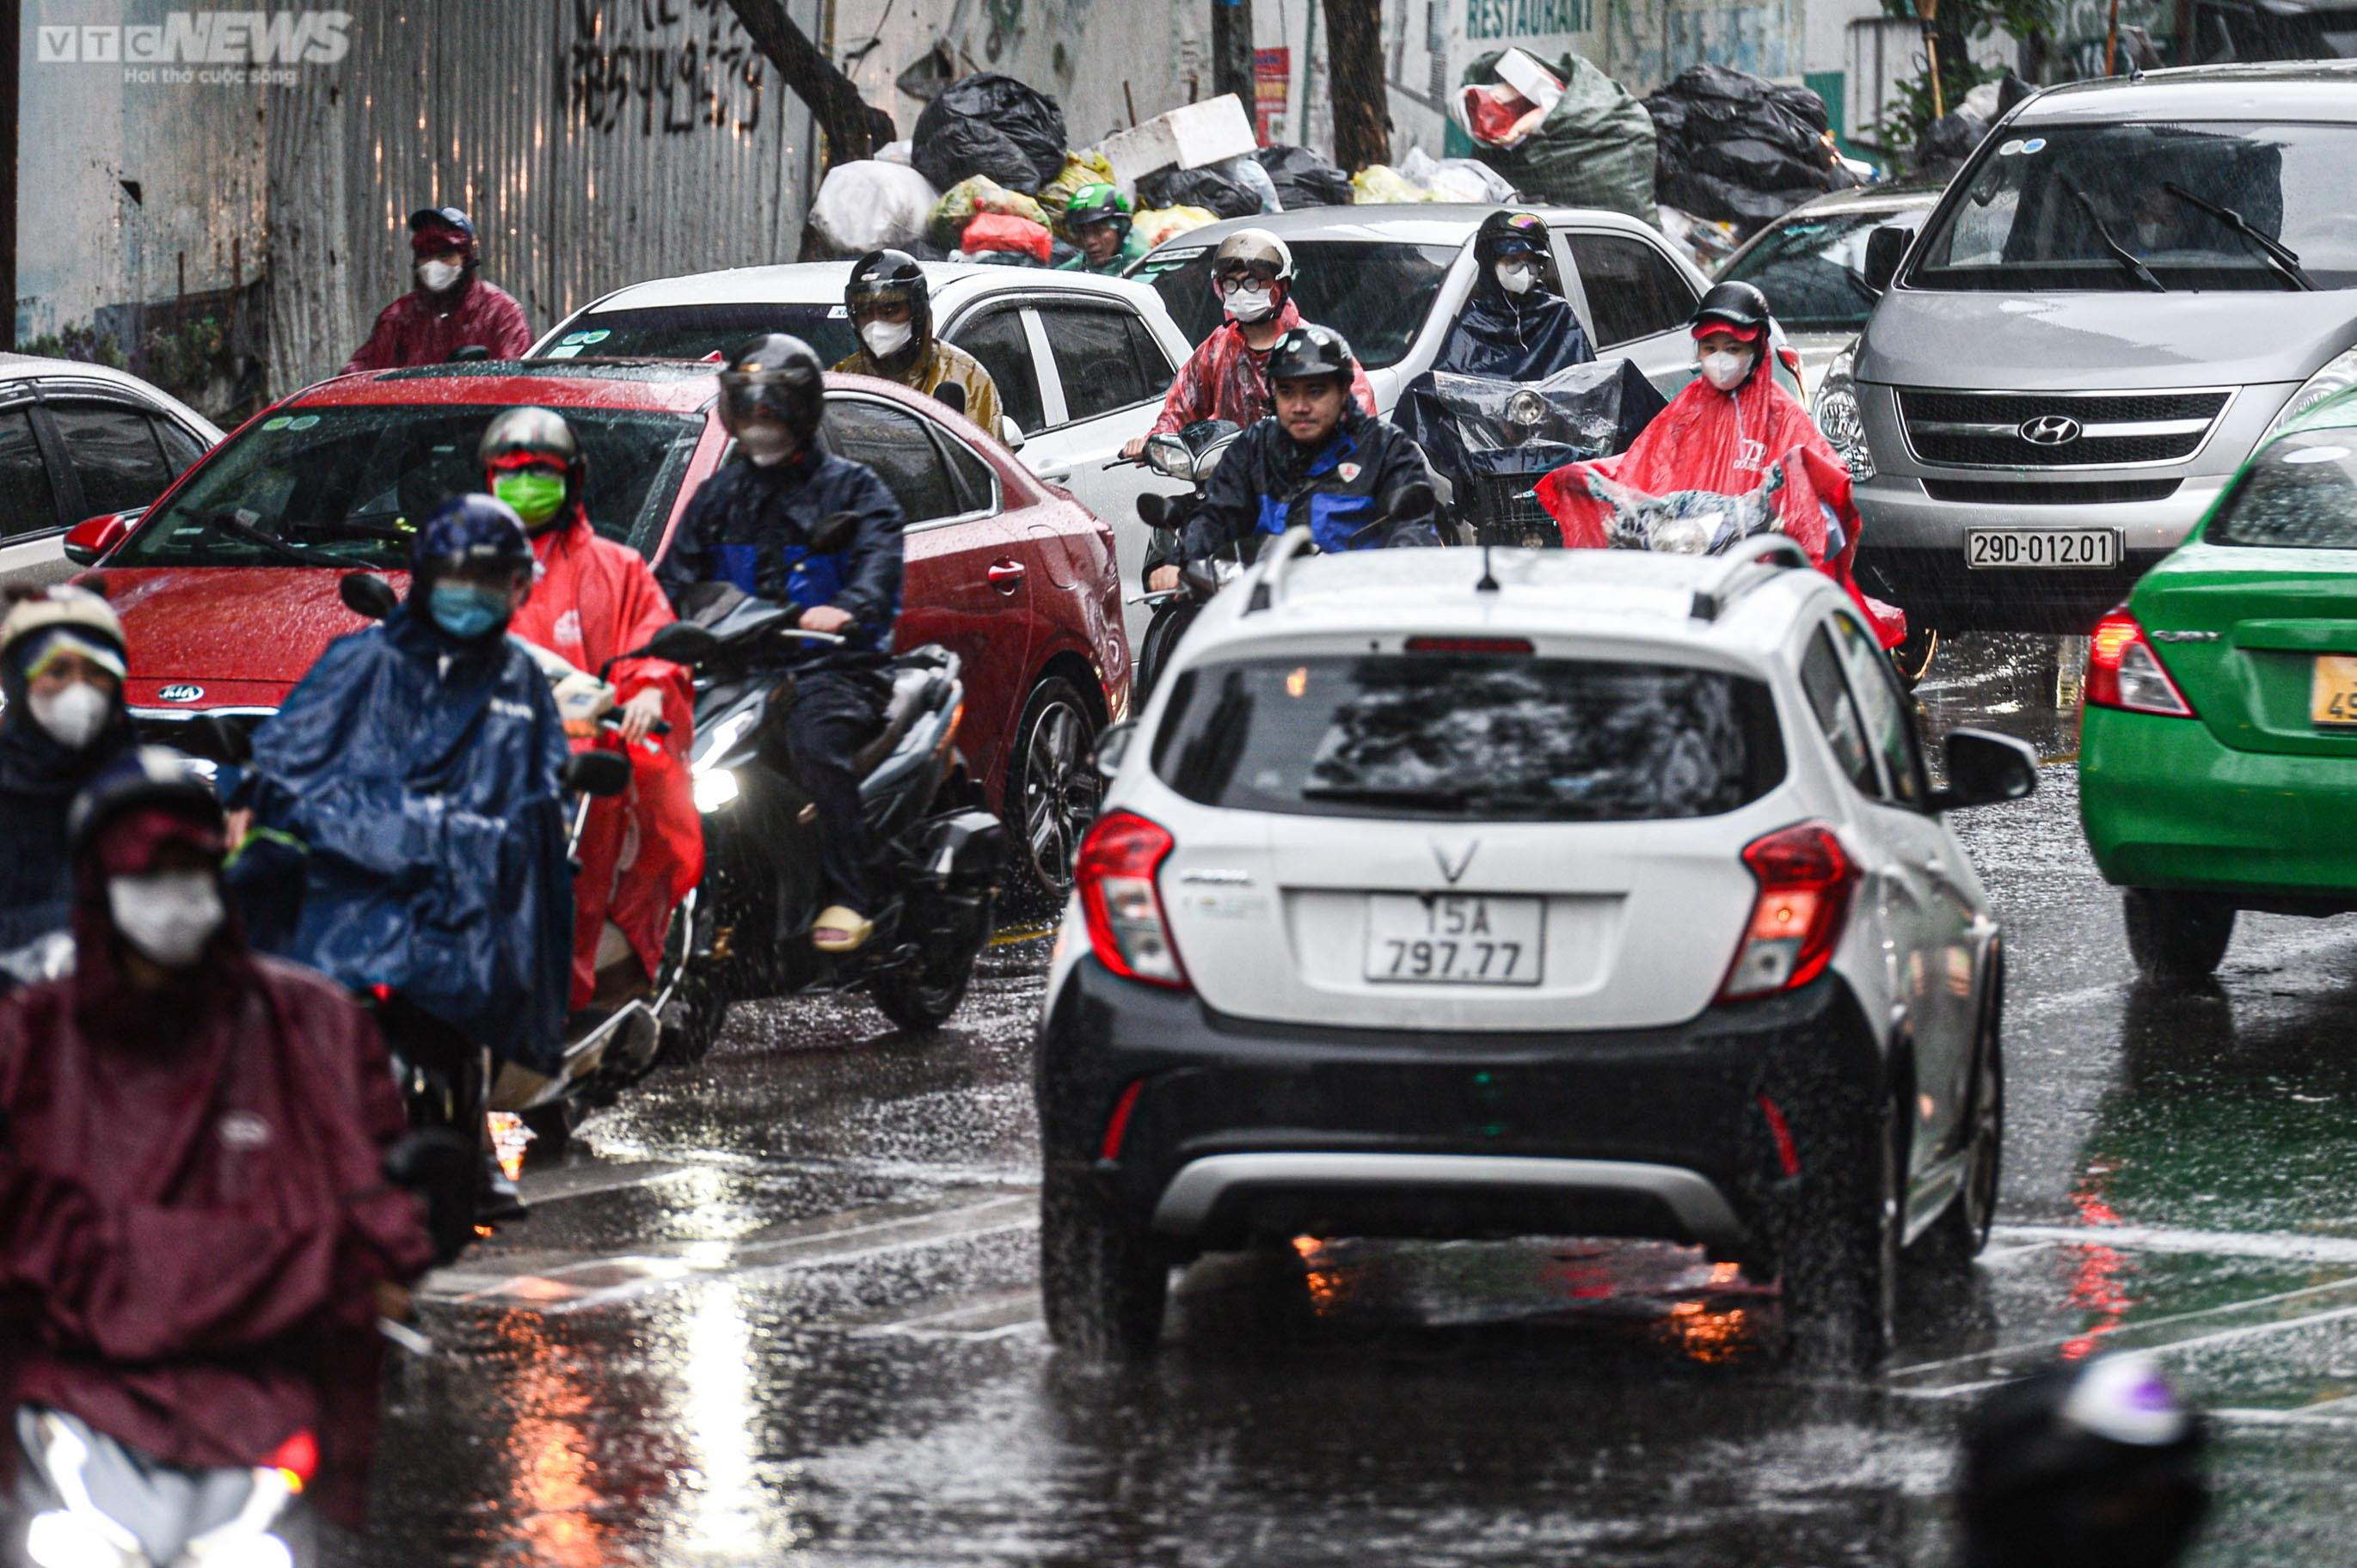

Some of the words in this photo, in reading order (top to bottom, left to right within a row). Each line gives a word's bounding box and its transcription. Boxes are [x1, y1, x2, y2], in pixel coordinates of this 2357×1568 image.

[1467, 0, 1592, 40] RESTAURANT
[1974, 535, 2107, 563] 29D-012.01
[1385, 940, 1521, 977] 797.77
